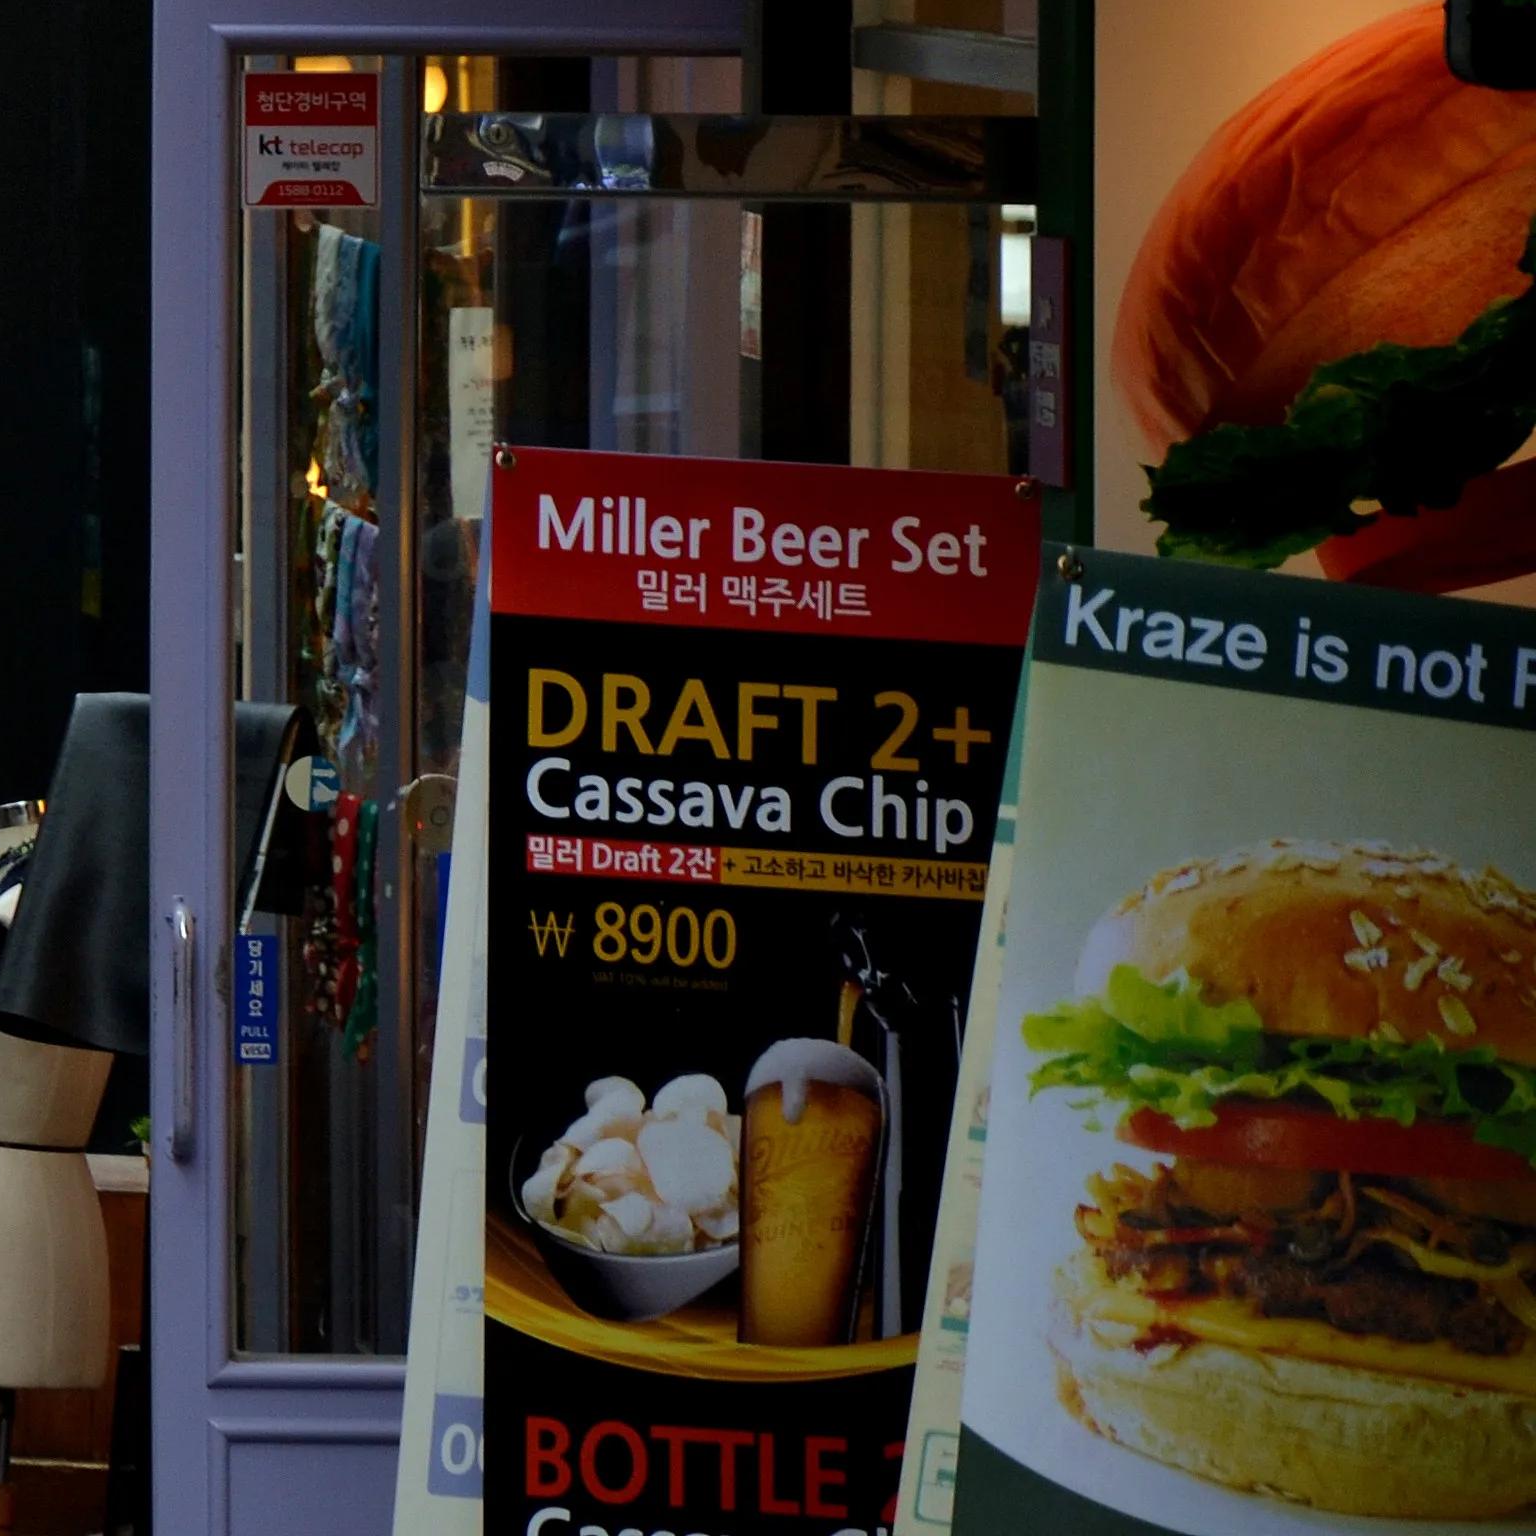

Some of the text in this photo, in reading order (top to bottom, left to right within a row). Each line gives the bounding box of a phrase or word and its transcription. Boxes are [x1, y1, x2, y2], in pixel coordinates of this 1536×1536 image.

[256, 91, 367, 112] 첨단경비구역
[259, 134, 364, 159] kt telecop
[538, 493, 988, 578] Miller Beer Set
[637, 568, 872, 621] 밀러 맥주세트
[1064, 583, 1270, 672] Kraze
[1294, 617, 1349, 684] is
[1376, 640, 1488, 704] not
[528, 667, 992, 772] DRAFT 2+
[526, 757, 974, 853] Cassava Chip
[528, 834, 585, 872] 밀러
[591, 842, 663, 875] Draft
[668, 845, 716, 882] 2잔
[743, 855, 826, 882] 고소하고
[833, 860, 895, 888] 바삭한
[902, 865, 986, 893] 카사바칩
[592, 901, 738, 969] 8900
[247, 939, 264, 1017] 당기세요
[240, 1025, 269, 1038] PULL
[526, 1416, 848, 1518] BOTTLE
